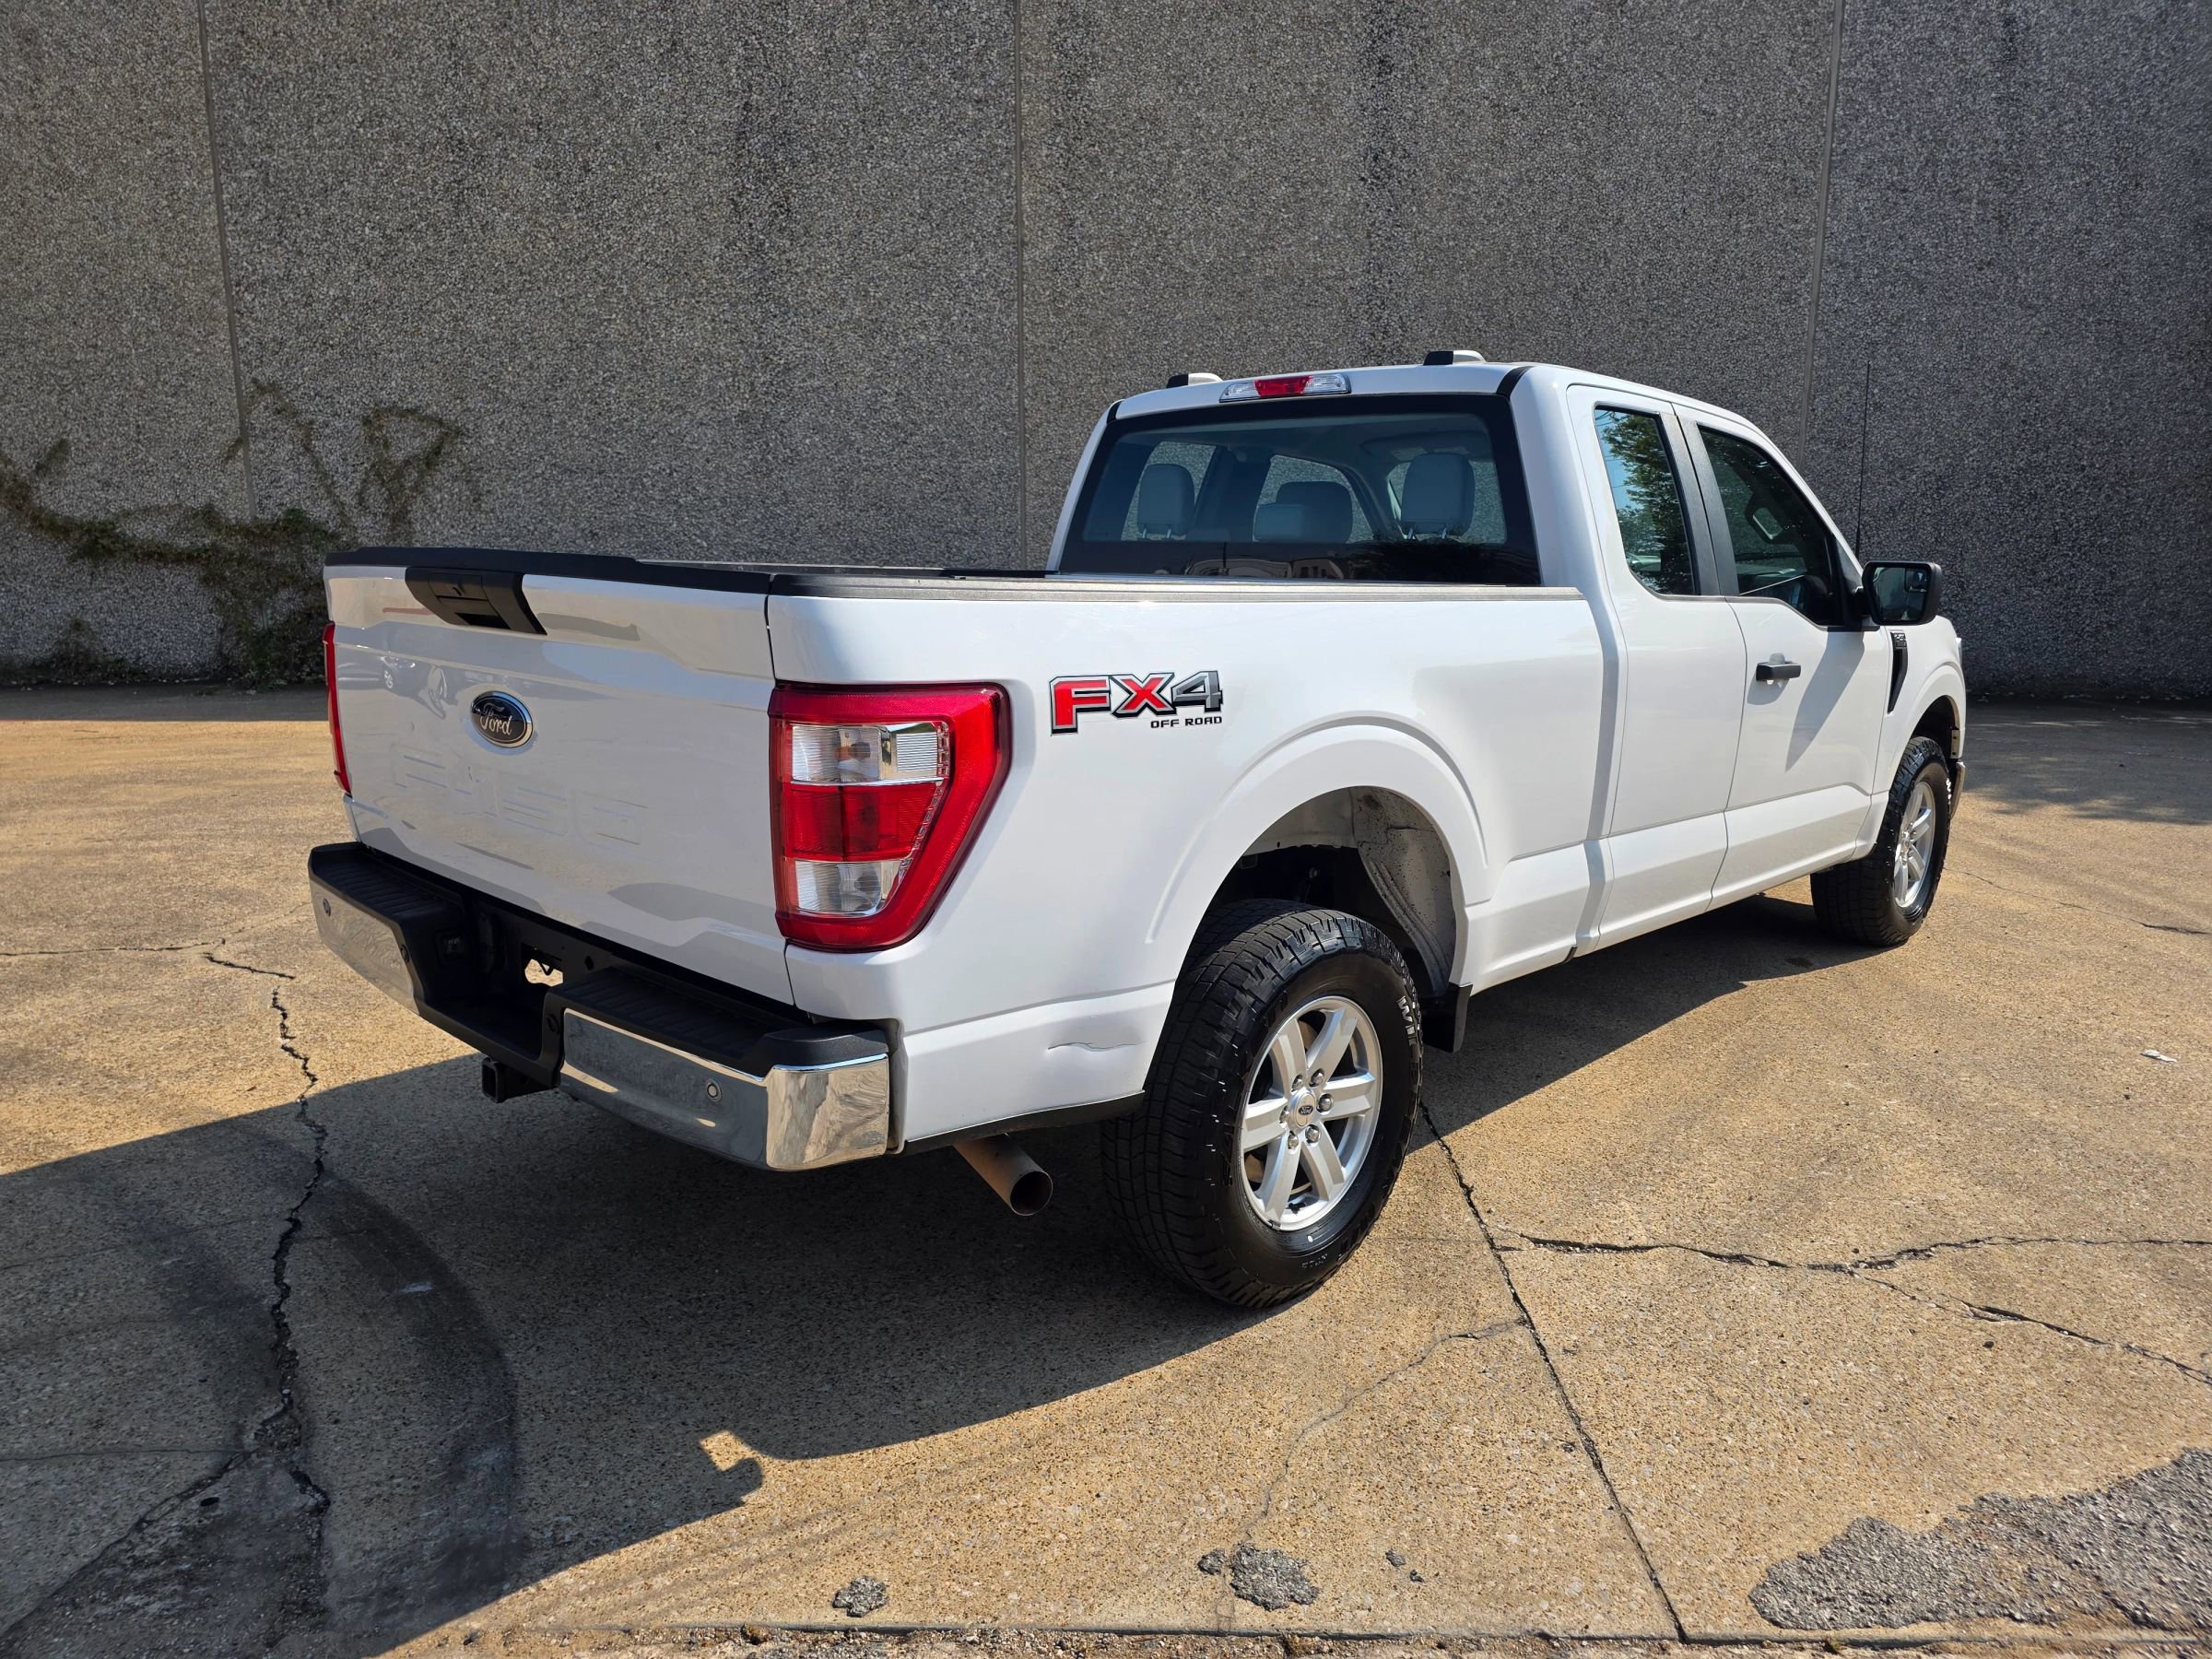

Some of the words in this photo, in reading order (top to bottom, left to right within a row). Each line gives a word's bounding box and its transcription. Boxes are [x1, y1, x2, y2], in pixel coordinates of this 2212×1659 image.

[479, 702, 513, 736] Ford
[1049, 670, 1223, 736] FX4
[1150, 719, 1180, 729] OFF
[1184, 716, 1223, 726] ROAD
